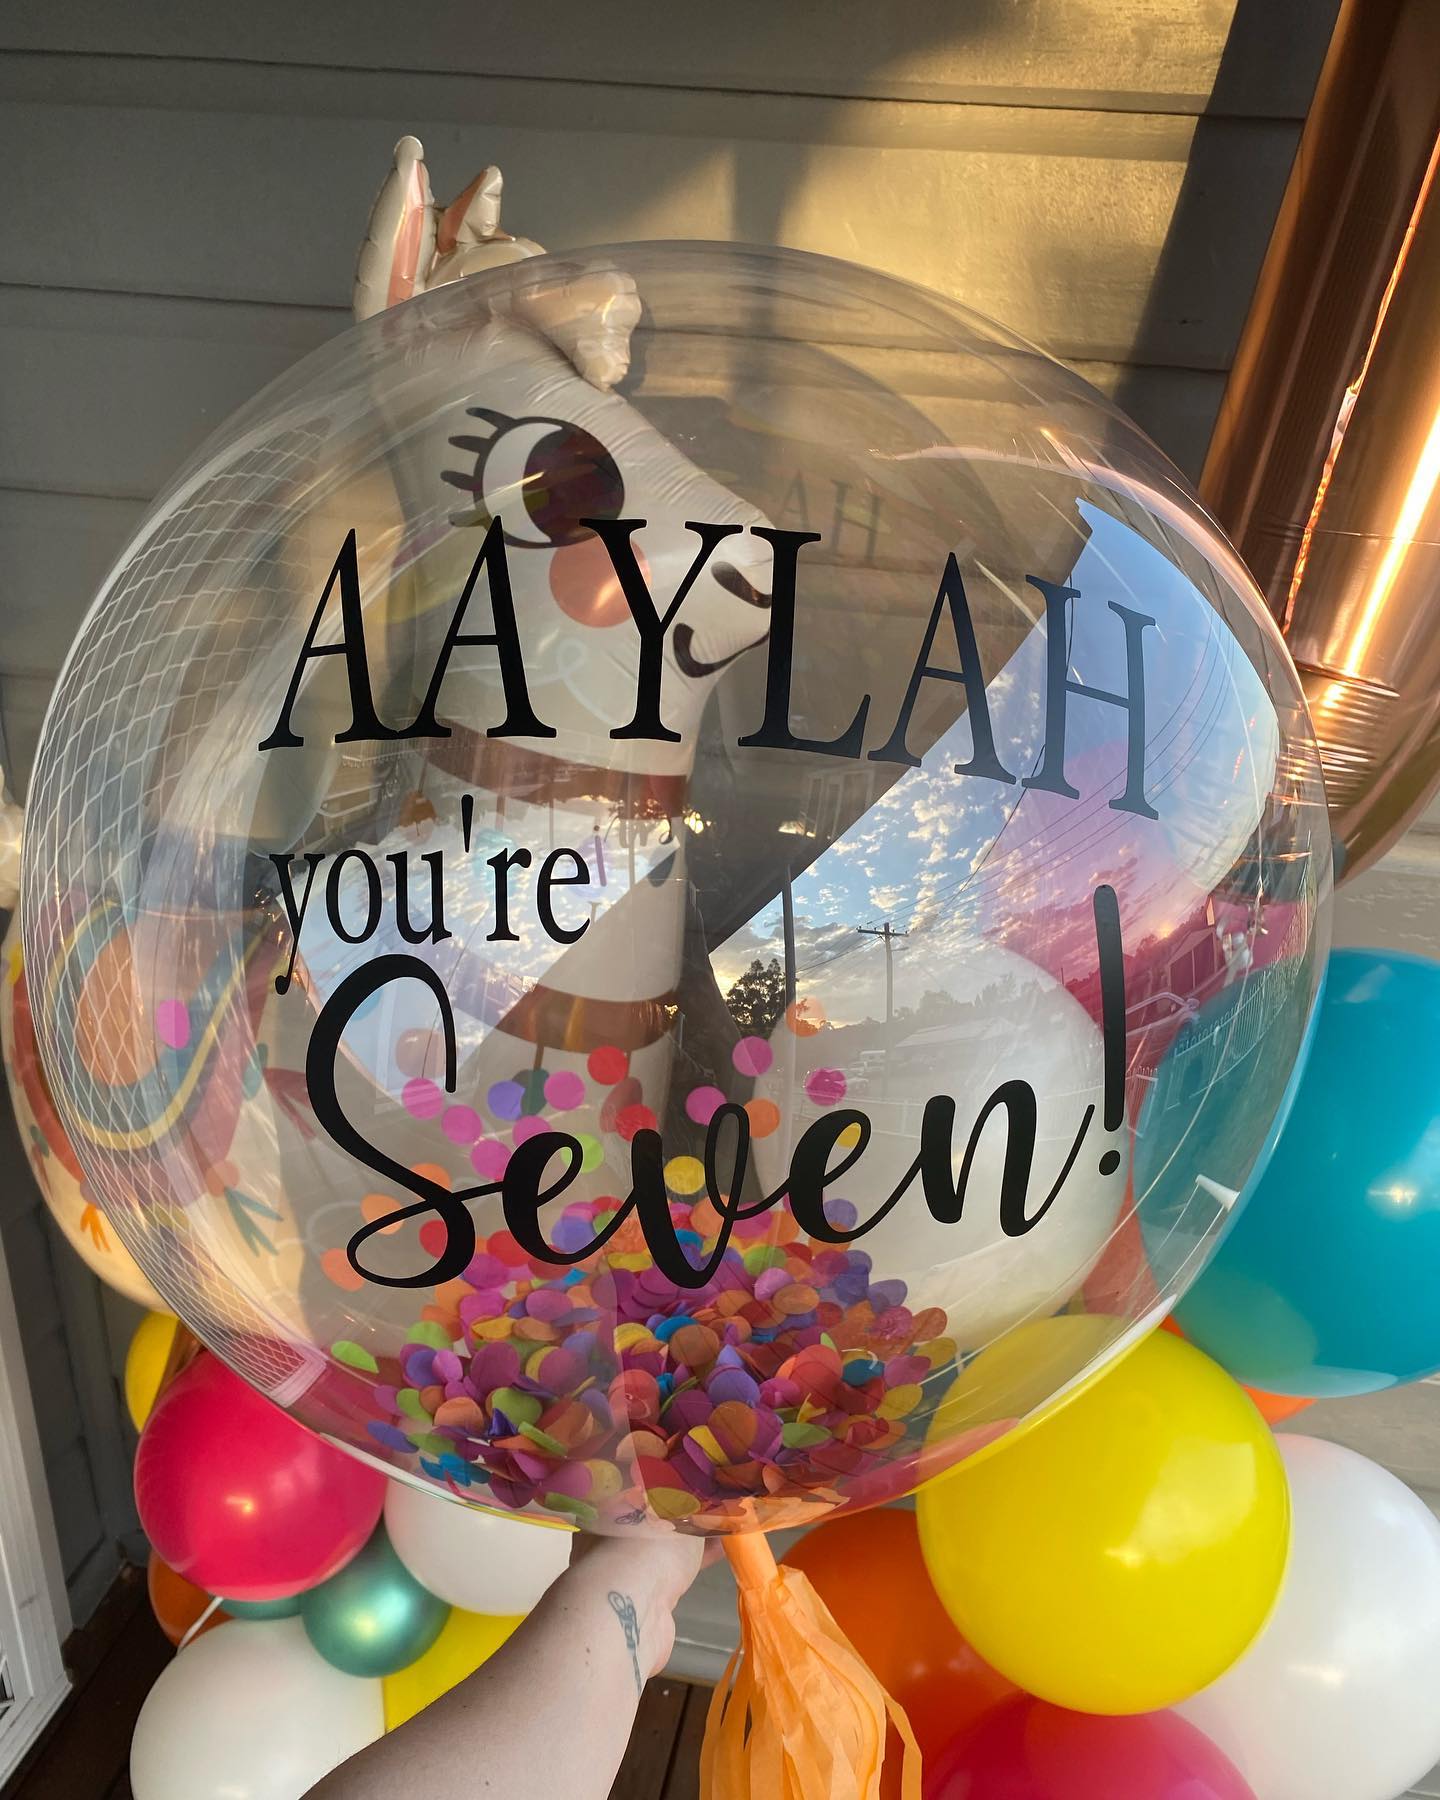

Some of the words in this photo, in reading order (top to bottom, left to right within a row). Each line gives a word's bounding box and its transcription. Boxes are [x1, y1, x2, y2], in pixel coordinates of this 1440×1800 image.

[258, 515, 1159, 821] AAYLAH
[269, 793, 591, 995] you're
[306, 884, 1125, 1289] Seven!
